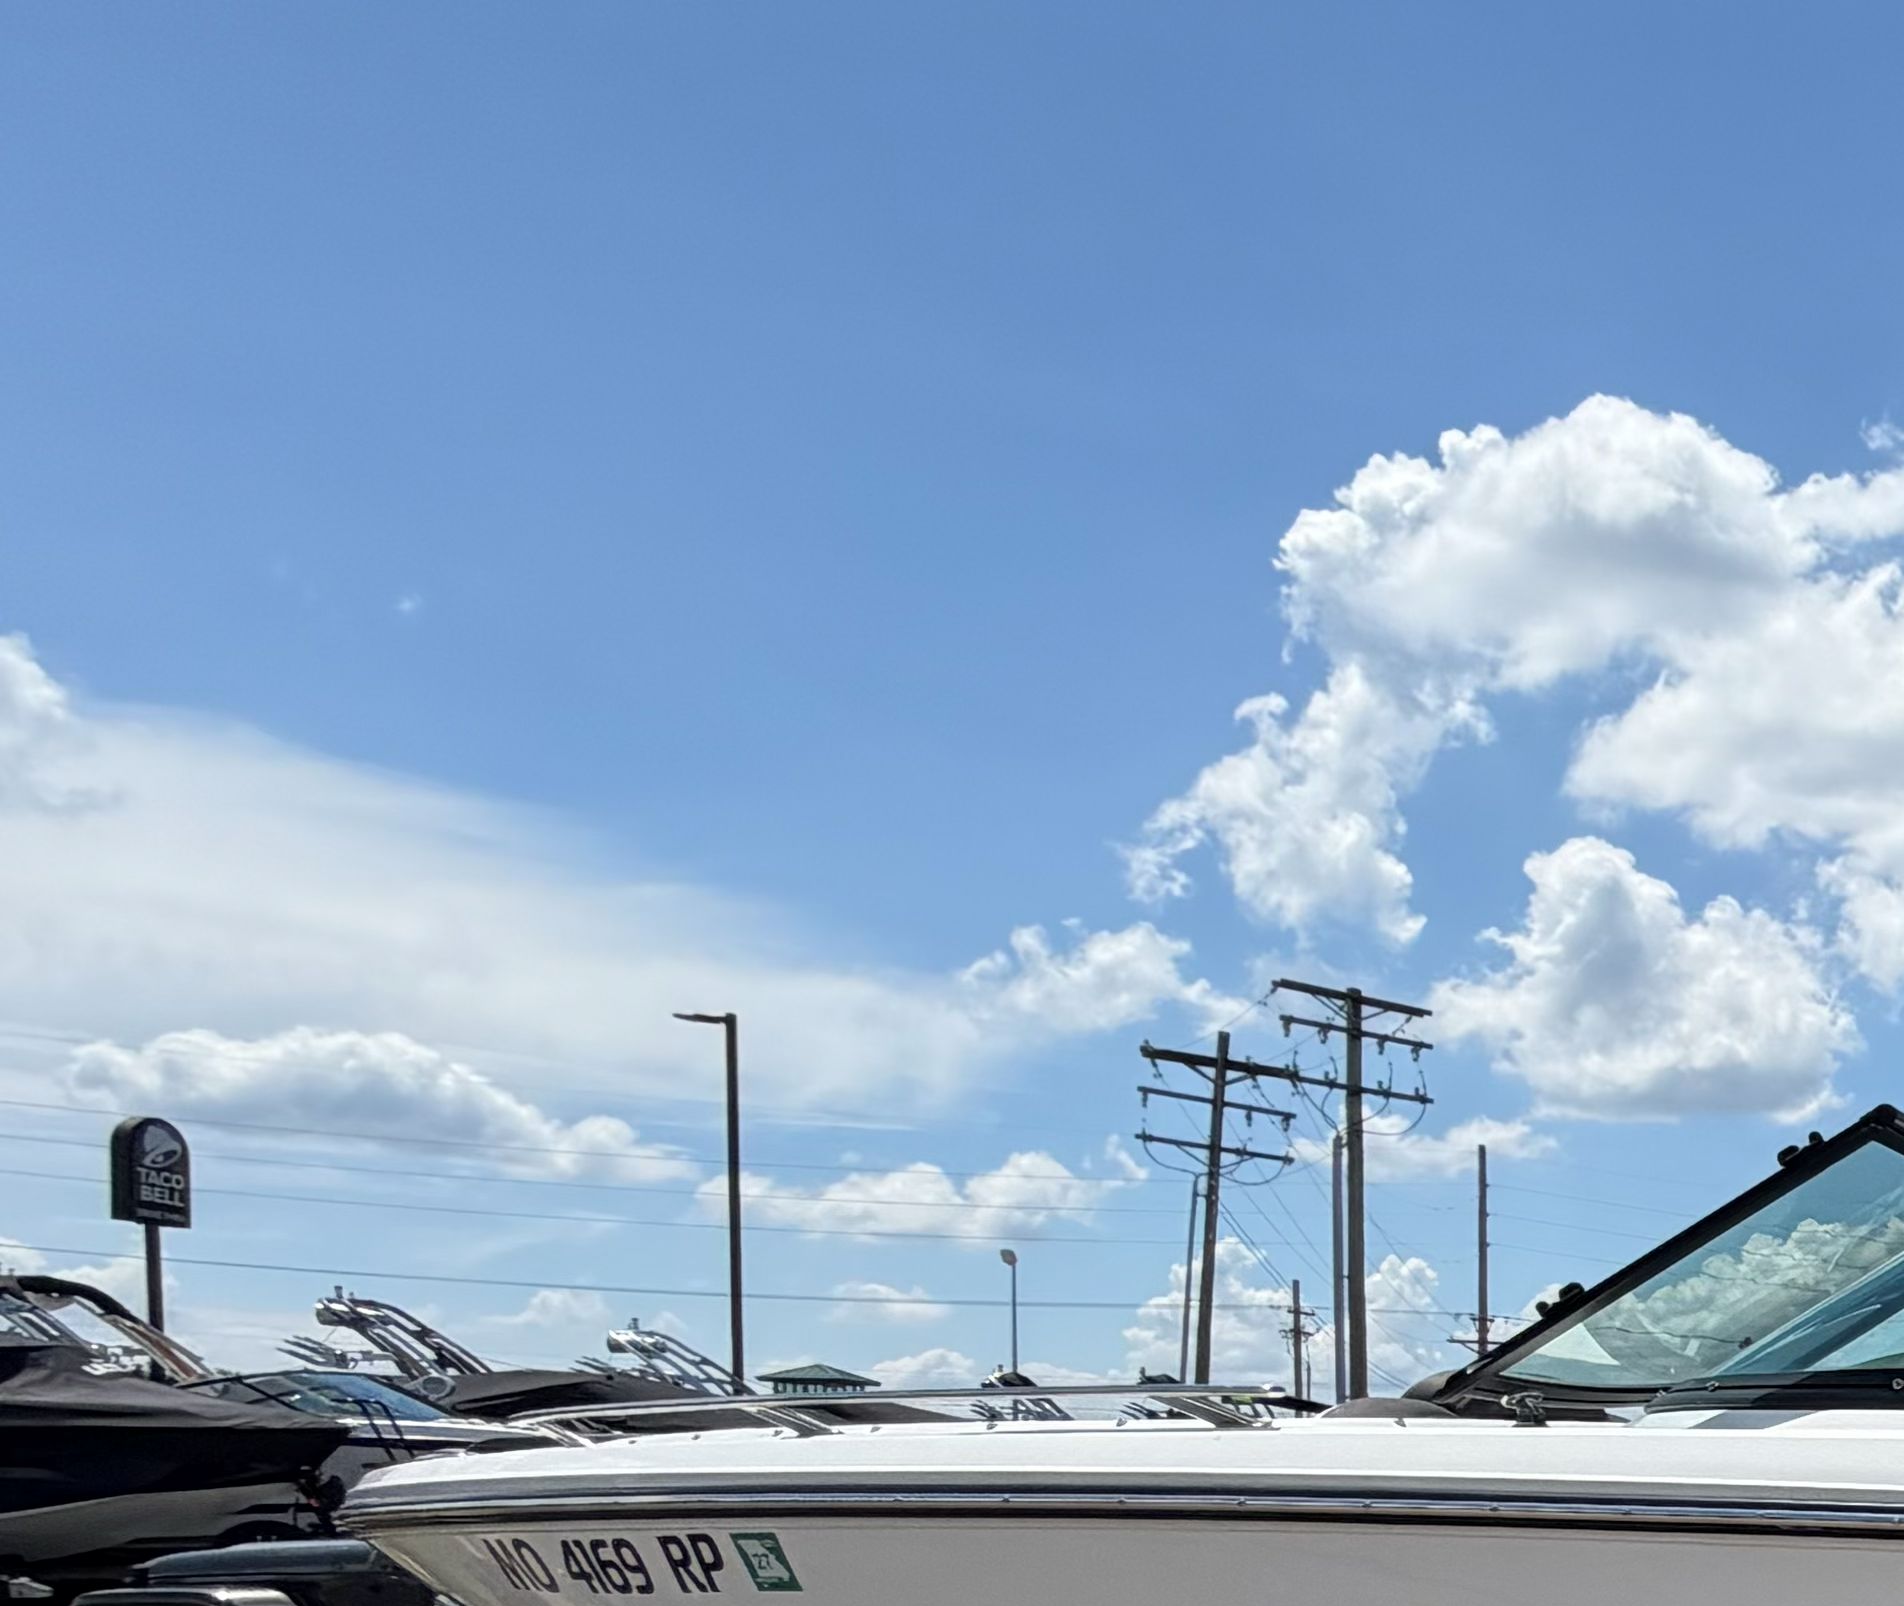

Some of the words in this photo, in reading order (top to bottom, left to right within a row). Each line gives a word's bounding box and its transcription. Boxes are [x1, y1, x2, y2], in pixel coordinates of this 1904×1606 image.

[136, 1166, 185, 1190] TACO
[141, 1184, 185, 1207] BELL
[483, 1538, 560, 1593] MO
[560, 1538, 655, 1594] 4169
[656, 1533, 725, 1593] RP
